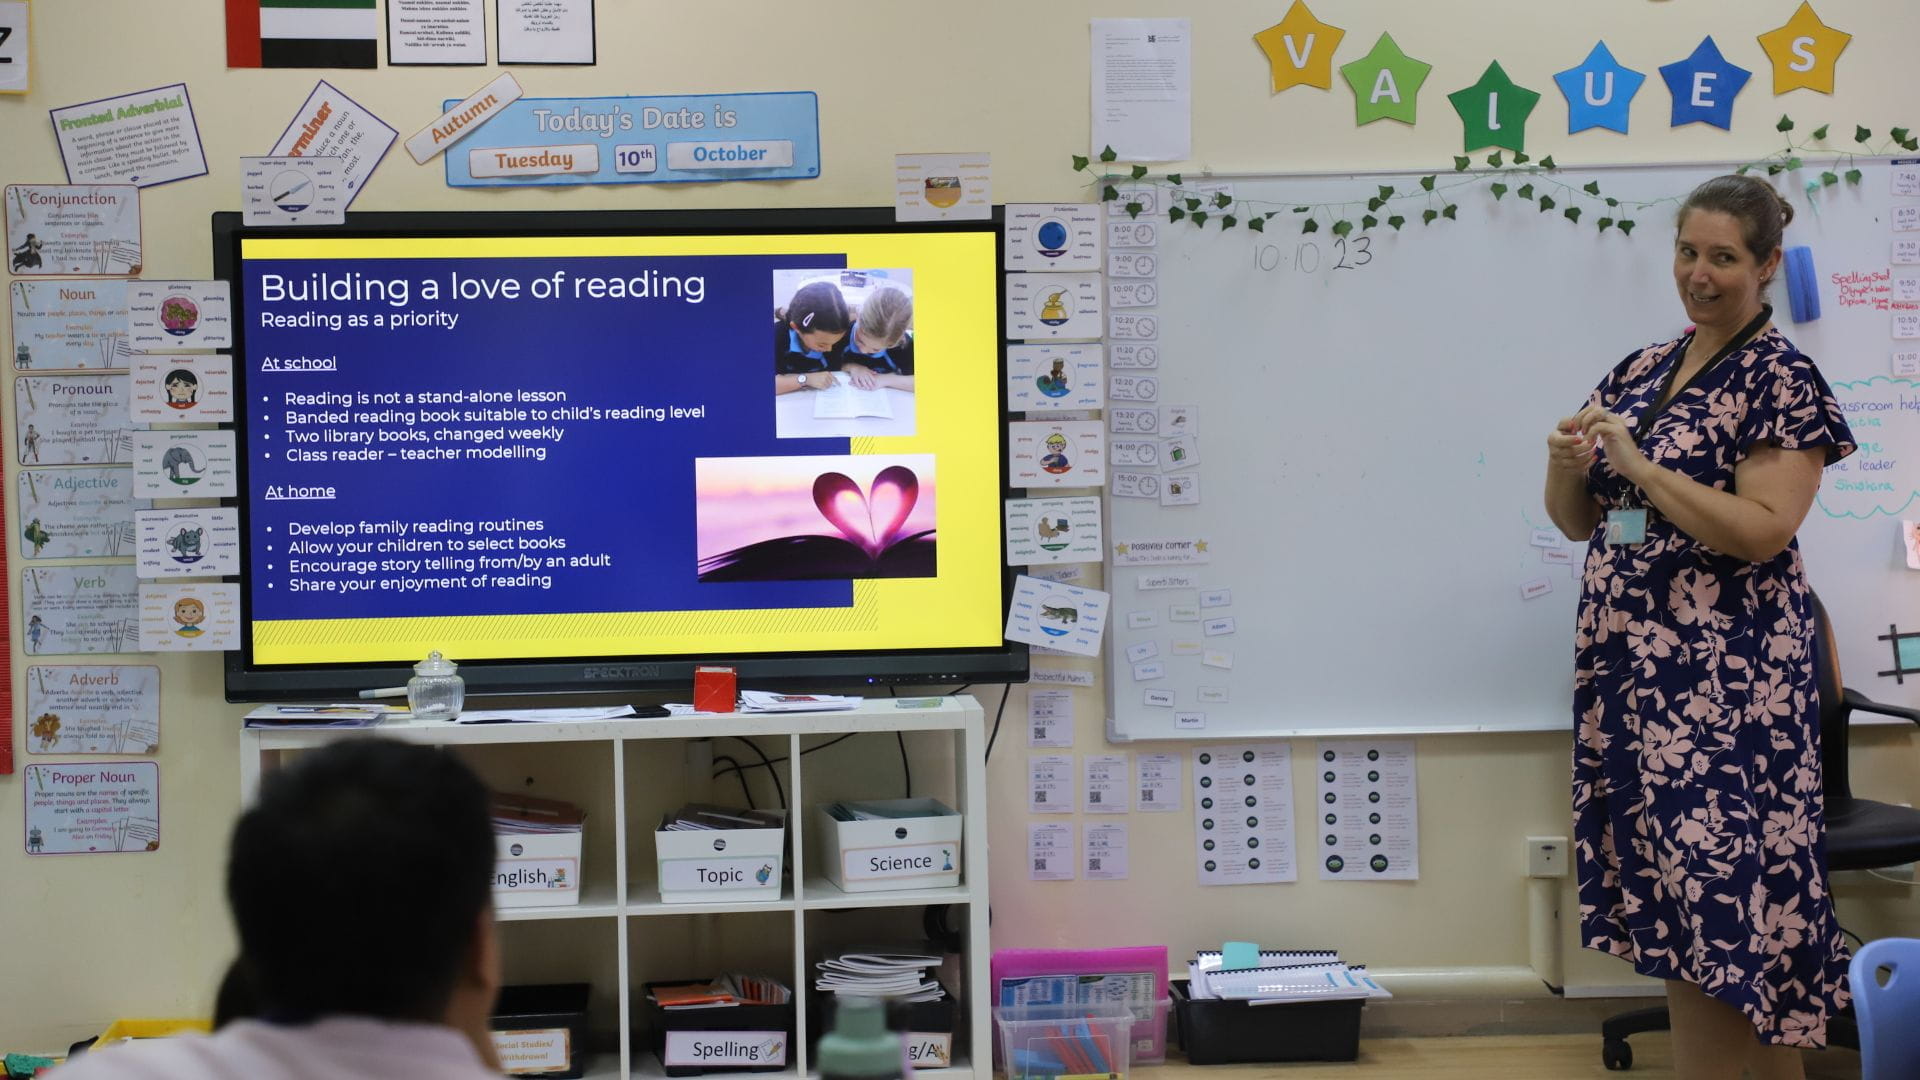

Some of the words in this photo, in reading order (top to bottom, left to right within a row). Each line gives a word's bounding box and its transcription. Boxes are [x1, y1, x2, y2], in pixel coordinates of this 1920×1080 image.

[61, 108, 114, 130] Fronted
[117, 95, 184, 120] Adverbial
[334, 111, 350, 131] noun
[431, 92, 498, 144] Autumn
[533, 105, 634, 137] Today's
[642, 105, 706, 130] Date
[713, 103, 738, 128] is
[288, 101, 332, 157] rminer
[338, 130, 351, 145] one
[348, 120, 356, 130] or
[494, 151, 573, 170] Tuesday
[619, 149, 654, 167] 10th
[692, 146, 768, 162] October
[1899, 173, 1916, 181] 7:40
[29, 192, 117, 208] Conjunction
[59, 288, 96, 301] Noun
[262, 273, 408, 306] Building
[422, 280, 438, 299] a
[452, 272, 520, 299] love
[531, 271, 565, 298] of
[575, 270, 704, 303] reading
[262, 311, 341, 330] Reading
[348, 315, 368, 326] as
[374, 315, 383, 326] a
[391, 310, 458, 330] priority
[262, 357, 281, 370] At
[284, 356, 336, 370] school
[52, 383, 113, 395] Pronoun
[286, 392, 352, 407] Reading
[358, 391, 369, 404] is
[374, 392, 400, 404] not
[405, 394, 413, 403] a
[418, 390, 513, 403] stand-alone
[518, 389, 566, 402] lesson
[287, 410, 348, 424] Banded
[354, 409, 415, 425] reading
[421, 409, 460, 422] book
[464, 408, 527, 421] suitable
[531, 409, 547, 420] to
[606, 406, 665, 421] reading
[670, 405, 704, 418] level
[285, 430, 319, 443] Two
[325, 429, 374, 445] library
[379, 428, 429, 443] books,
[434, 427, 504, 443] changed
[508, 426, 564, 441] weekly
[287, 449, 327, 461] Class
[333, 448, 384, 461] reader
[400, 446, 461, 460] teacher
[466, 445, 546, 461] modelling
[1859, 459, 1896, 471] leader
[54, 476, 118, 492] Adjective
[265, 486, 284, 499] At
[288, 485, 336, 499] home
[289, 522, 355, 537] Develop
[359, 520, 408, 536] family
[413, 519, 473, 535] reading
[479, 518, 544, 531] routines
[289, 541, 333, 554] Allow
[337, 543, 373, 556] your
[378, 539, 442, 552] children
[447, 539, 463, 550] to
[468, 537, 514, 550] select
[519, 536, 566, 549] books
[290, 560, 377, 574] Encourage
[382, 559, 421, 573] story
[425, 557, 474, 572] telling
[479, 553, 542, 570] from/by
[546, 557, 565, 567] an
[570, 553, 611, 567] adult
[74, 577, 106, 589] Verb
[290, 578, 336, 591] Share
[340, 580, 376, 593] your
[380, 576, 467, 592] enjoyment
[472, 575, 487, 587] of
[492, 574, 551, 589] reading
[70, 673, 119, 686] Adverb
[52, 771, 96, 787] Proper
[100, 771, 136, 783] Noun
[869, 854, 933, 874] Science
[696, 866, 743, 885] Topic
[692, 1040, 760, 1059] Spelling
